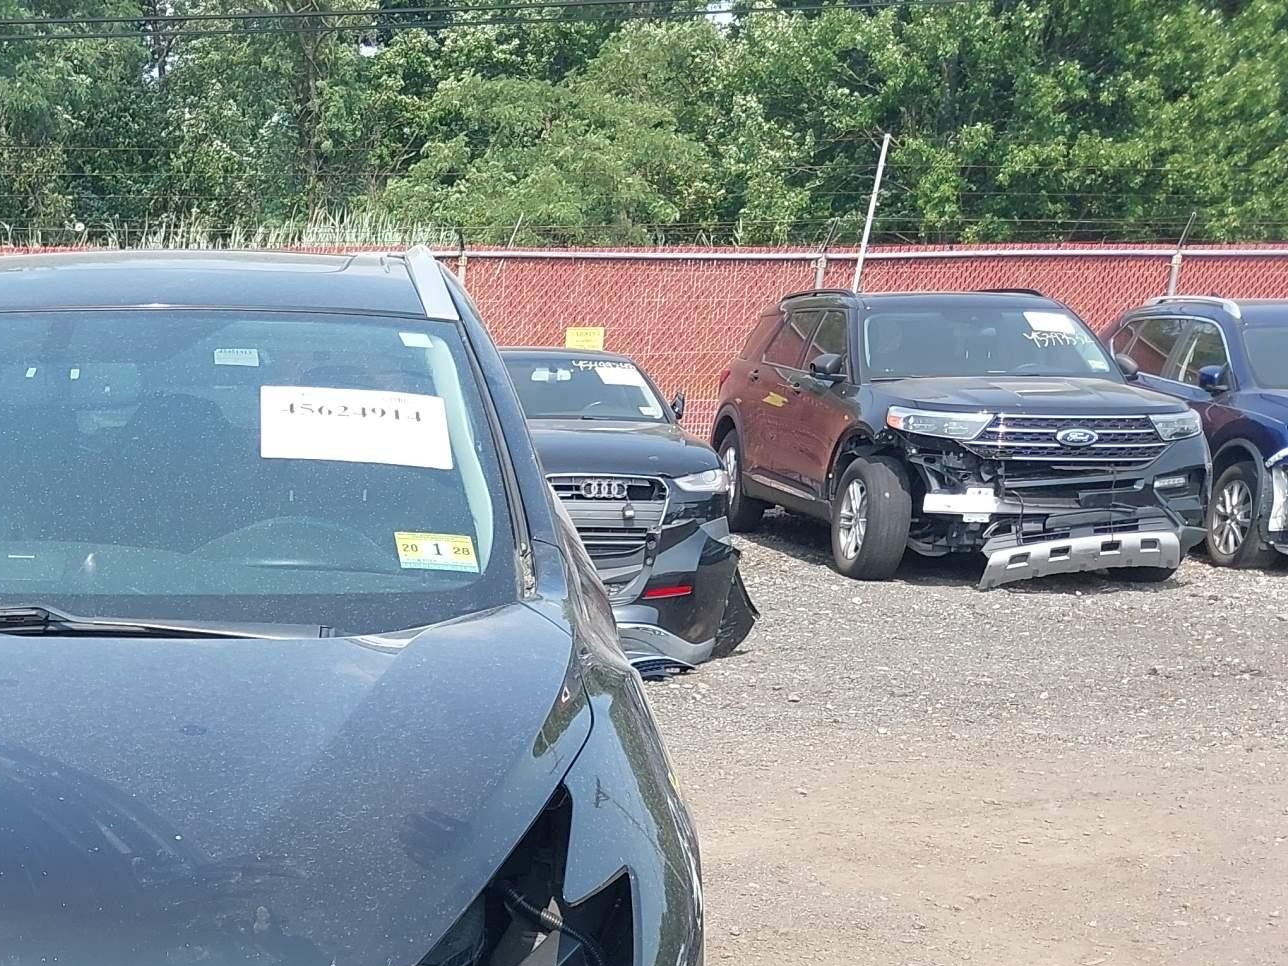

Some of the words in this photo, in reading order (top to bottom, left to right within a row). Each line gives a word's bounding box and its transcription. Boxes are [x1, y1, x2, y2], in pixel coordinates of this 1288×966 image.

[280, 403, 421, 422] 45624914
[1067, 430, 1090, 442] Ford
[402, 543, 418, 553] 20
[433, 543, 442, 556] 1
[452, 546, 470, 556] 28
